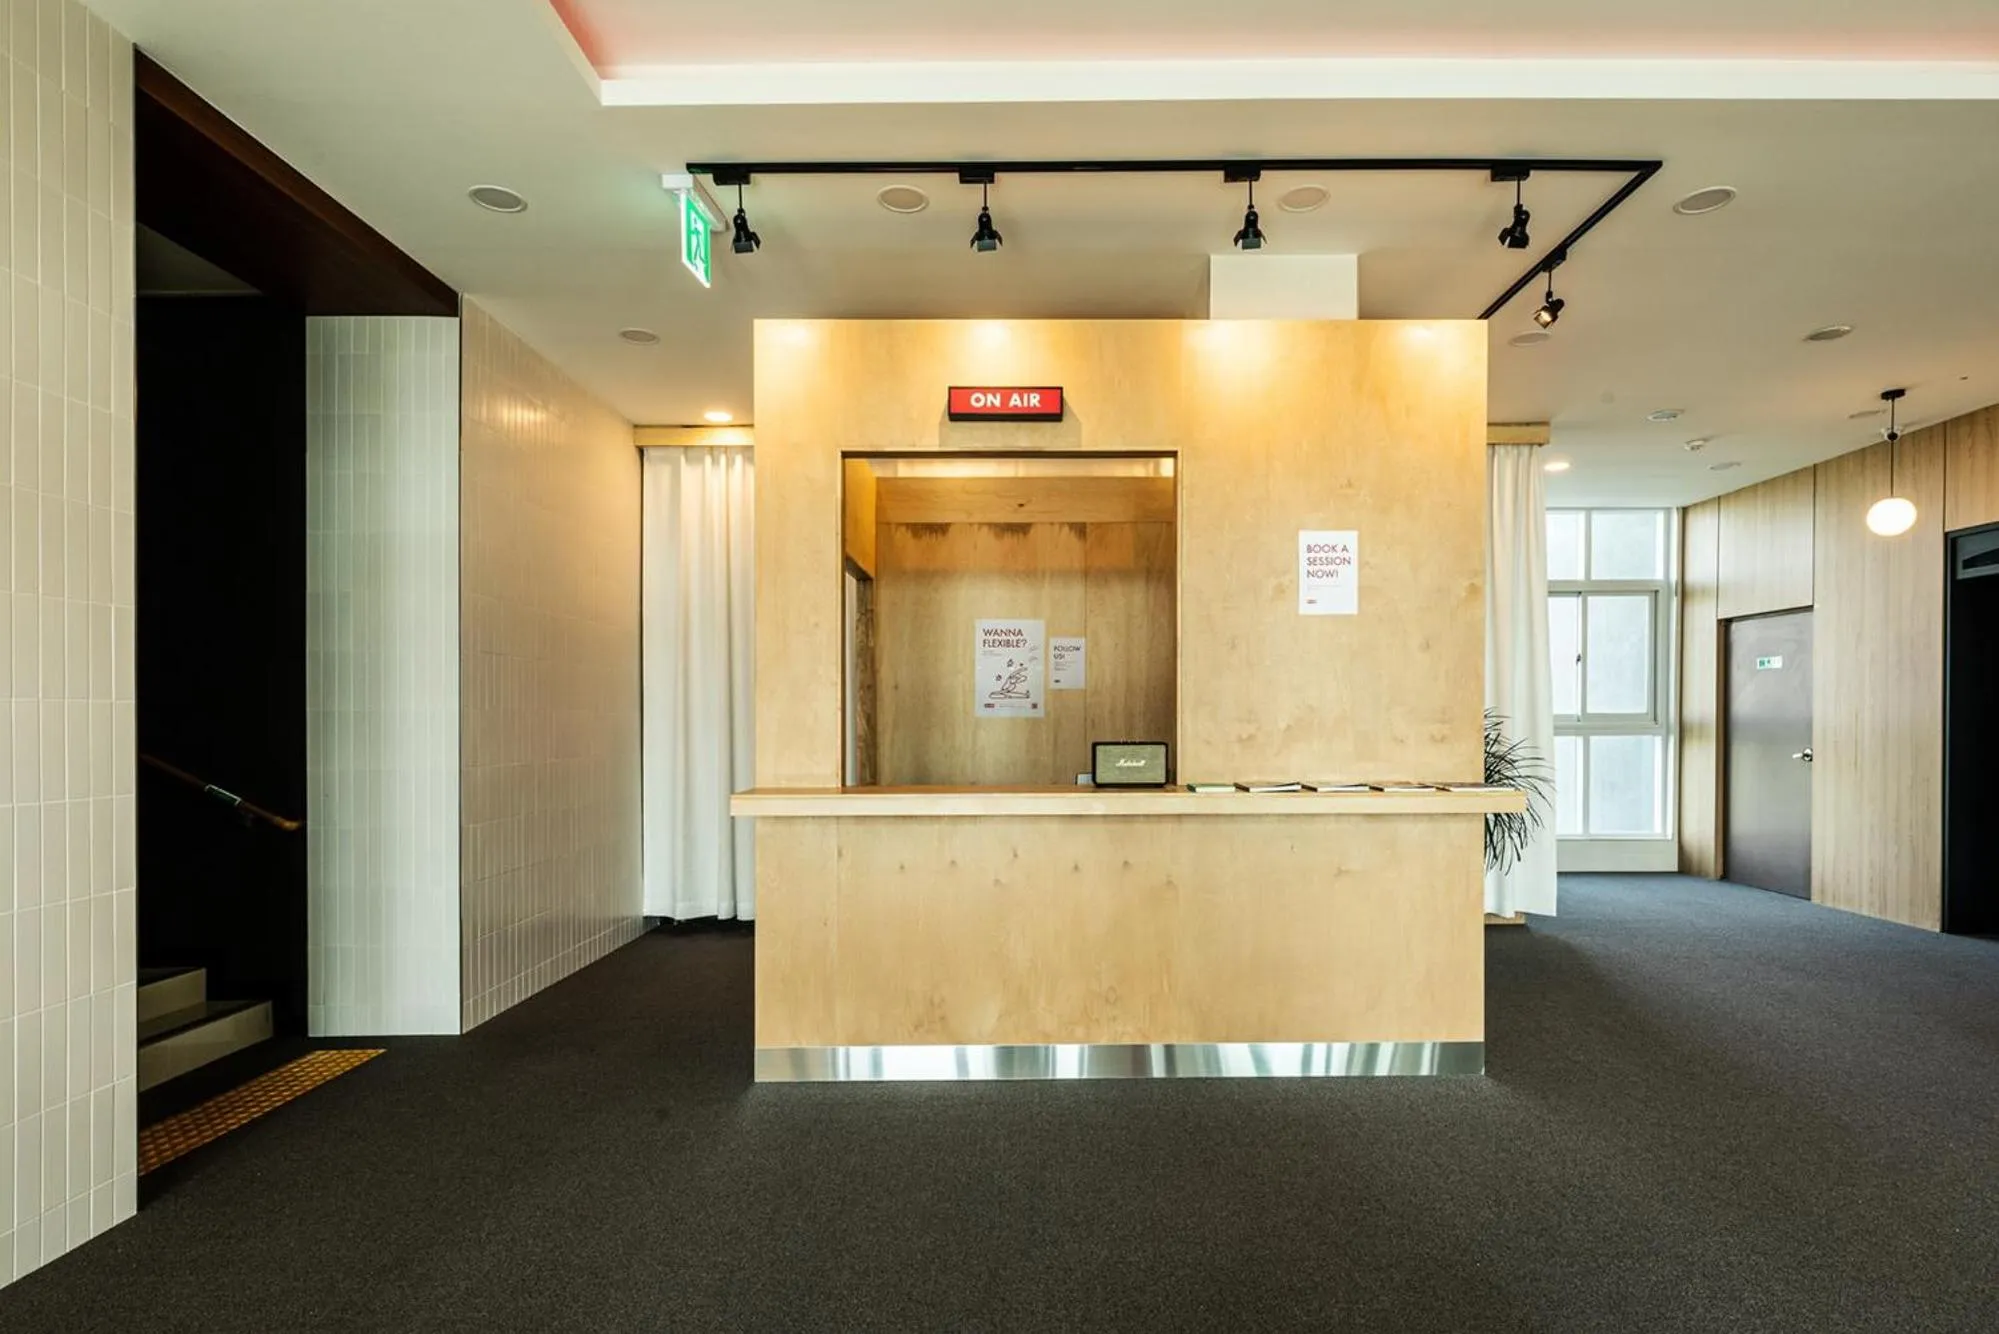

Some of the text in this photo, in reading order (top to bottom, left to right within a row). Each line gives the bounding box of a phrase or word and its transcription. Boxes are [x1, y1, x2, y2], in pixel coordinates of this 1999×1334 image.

[970, 392, 1041, 408] ON AIR
[1306, 544, 1349, 553] BOOK A
[1306, 556, 1351, 566] SESSION
[1306, 569, 1339, 578] NOW!
[982, 628, 1023, 637] WANNA
[982, 639, 1027, 648] FLEXIBLE?
